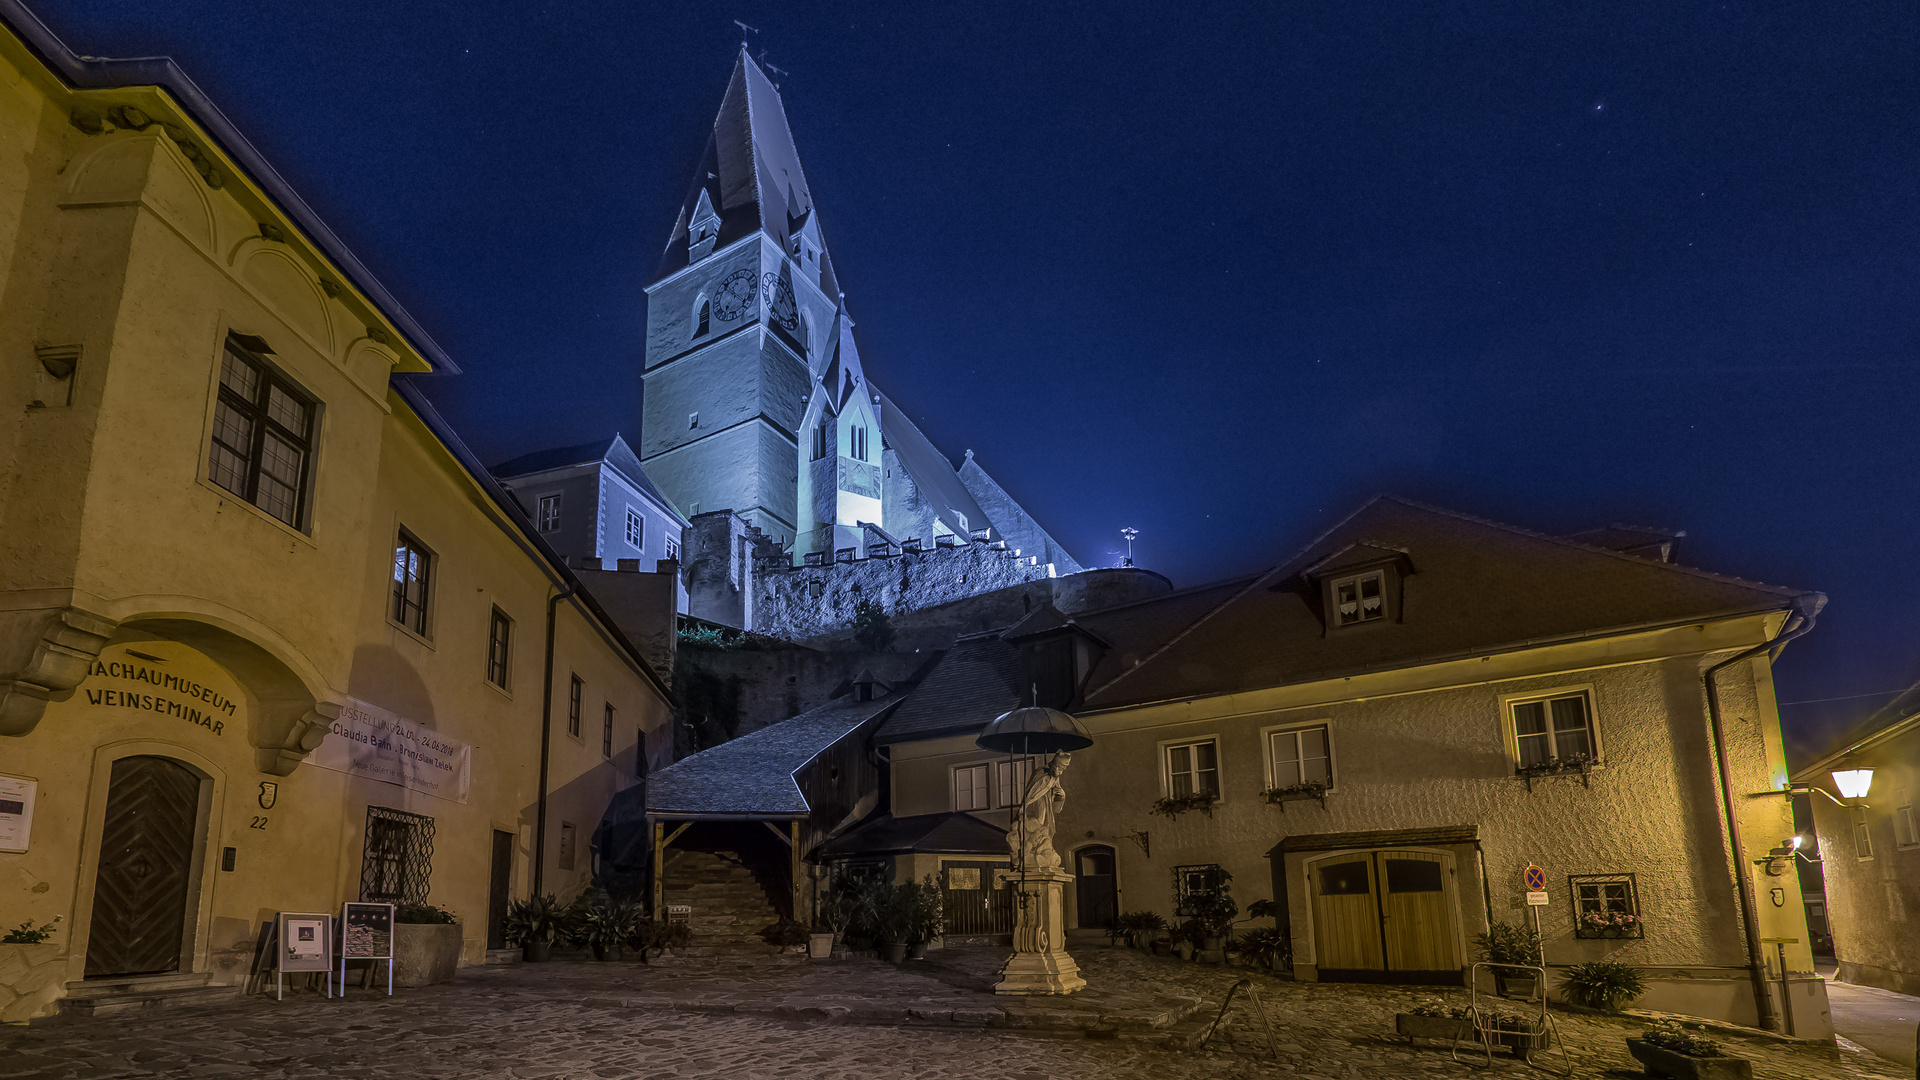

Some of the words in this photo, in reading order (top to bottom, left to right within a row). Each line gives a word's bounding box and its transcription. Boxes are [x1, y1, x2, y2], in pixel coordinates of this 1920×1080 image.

[85, 689, 225, 736] WEINSEMINAR
[341, 706, 396, 733] USSTELLUNG
[421, 736, 454, 756] 24.06.2018
[333, 723, 368, 744] Claudia
[434, 757, 454, 773] Zelek
[353, 759, 368, 771] Neue
[370, 763, 396, 777] Galerie
[250, 815, 268, 830] 22
